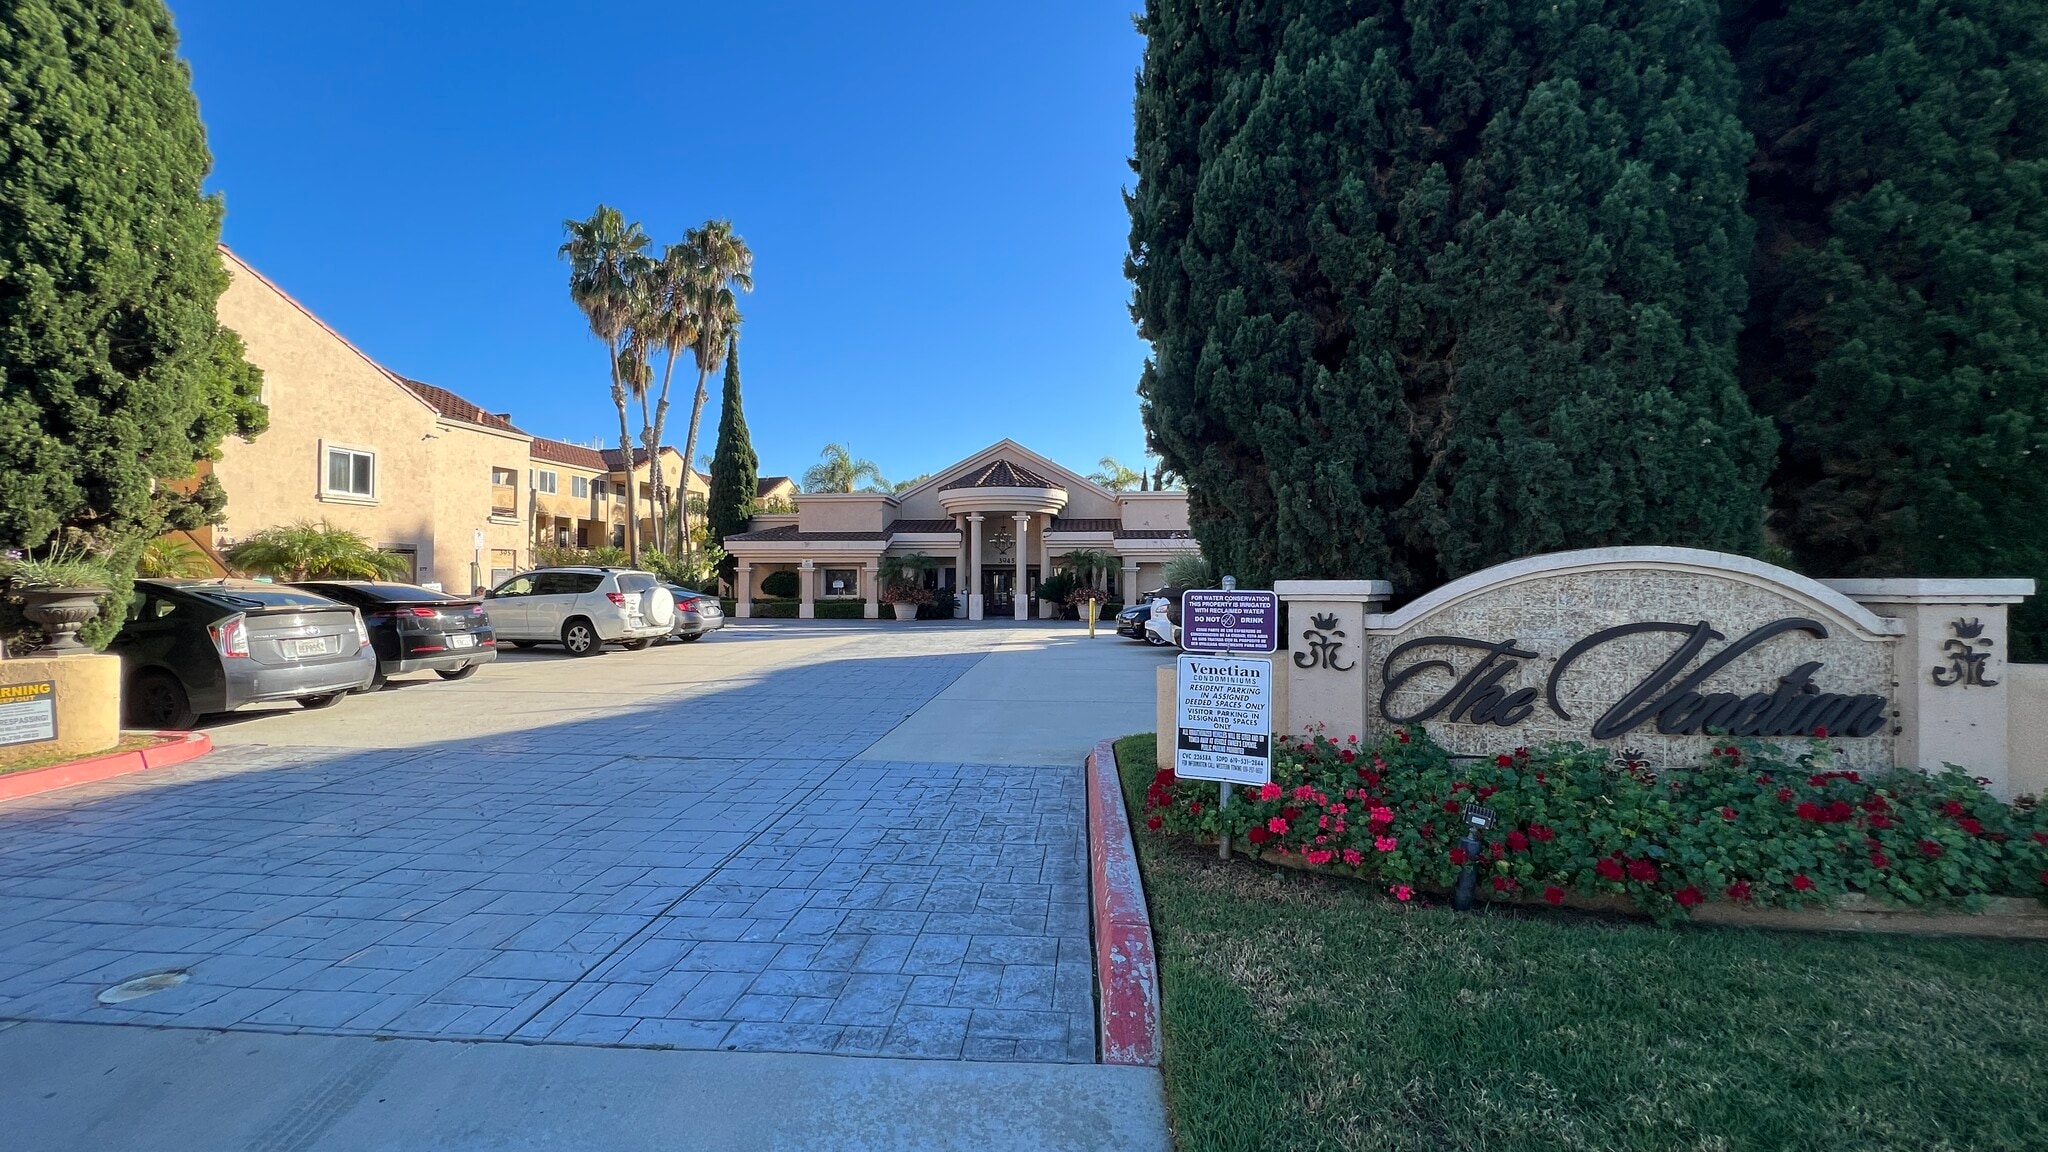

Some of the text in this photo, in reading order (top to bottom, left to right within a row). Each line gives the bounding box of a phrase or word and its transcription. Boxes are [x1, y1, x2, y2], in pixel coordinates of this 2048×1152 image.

[1190, 663, 1260, 678] Venetian
[1193, 675, 1257, 684] CONDOMINIUMS
[1379, 617, 1888, 741] The Venetian
[0, 684, 50, 698] RNING
[1190, 684, 1261, 695] RESIDENT PARKING
[1212, 693, 1249, 701] ASSIGNED
[1215, 700, 1242, 708] SPACES
[1188, 714, 1230, 723] DESIGNATED
[1217, 710, 1248, 718] PARKING
[0, 715, 48, 725] RESPASSING!
